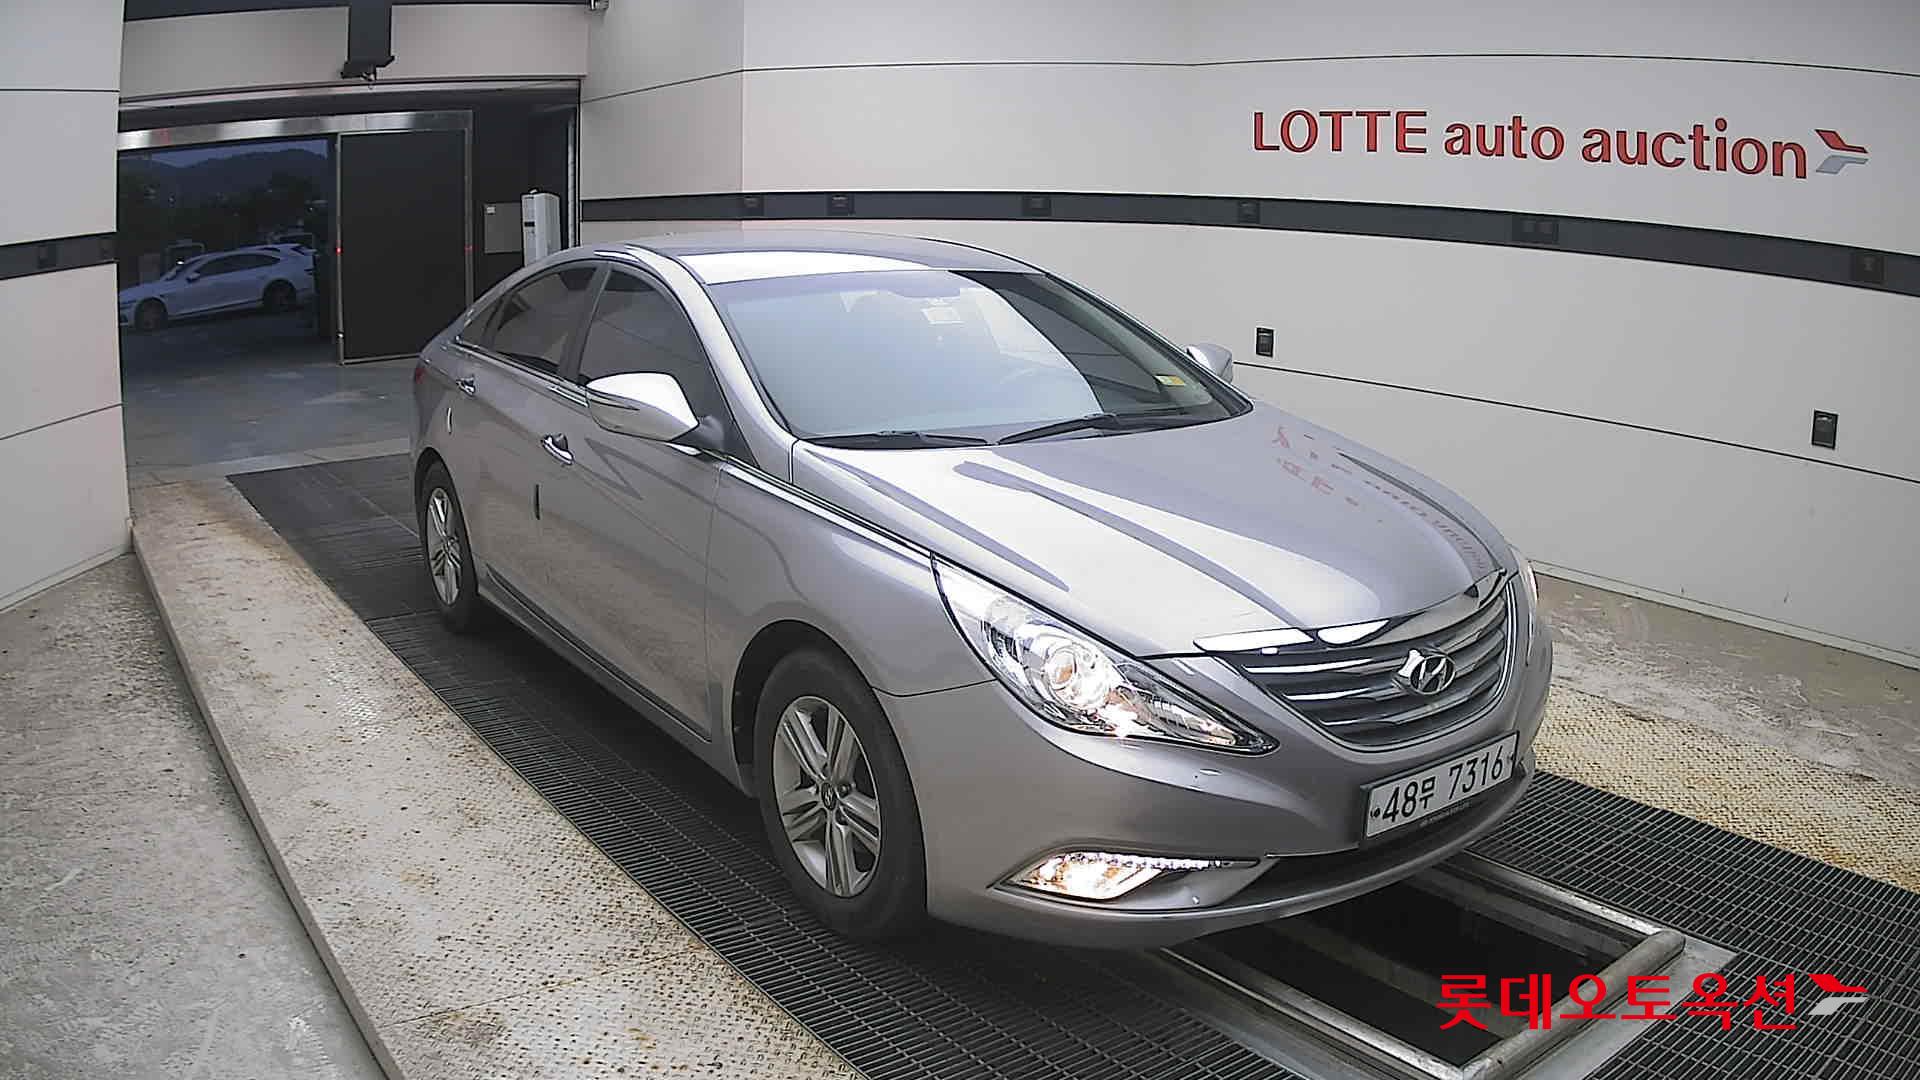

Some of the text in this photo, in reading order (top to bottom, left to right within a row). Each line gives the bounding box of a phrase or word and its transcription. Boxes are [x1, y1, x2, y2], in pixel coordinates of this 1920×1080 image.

[1253, 110, 1808, 179] LOTTE auto auction
[1382, 776, 1436, 822] 48무
[1448, 745, 1504, 800] 7316
